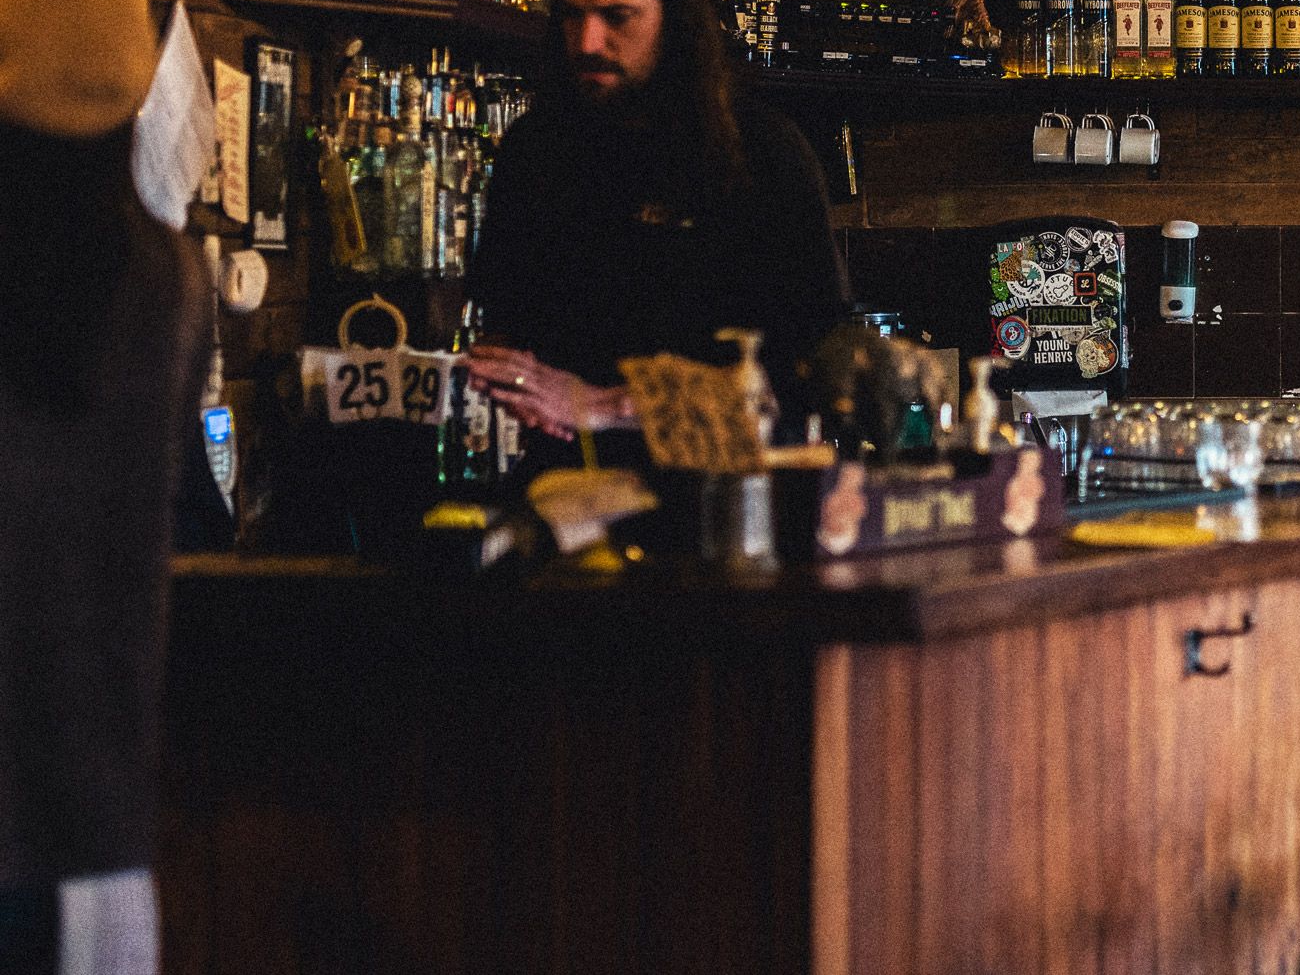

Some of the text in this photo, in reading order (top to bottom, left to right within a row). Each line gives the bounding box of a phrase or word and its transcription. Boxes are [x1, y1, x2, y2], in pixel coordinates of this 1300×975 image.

[1210, 8, 1240, 18] JAMESON
[1243, 8, 1273, 18] JAMESON
[1032, 308, 1087, 323] FIXATION
[1036, 340, 1070, 352] YOUNG
[1034, 352, 1073, 364] HENRYS
[337, 360, 441, 412] 25 29
